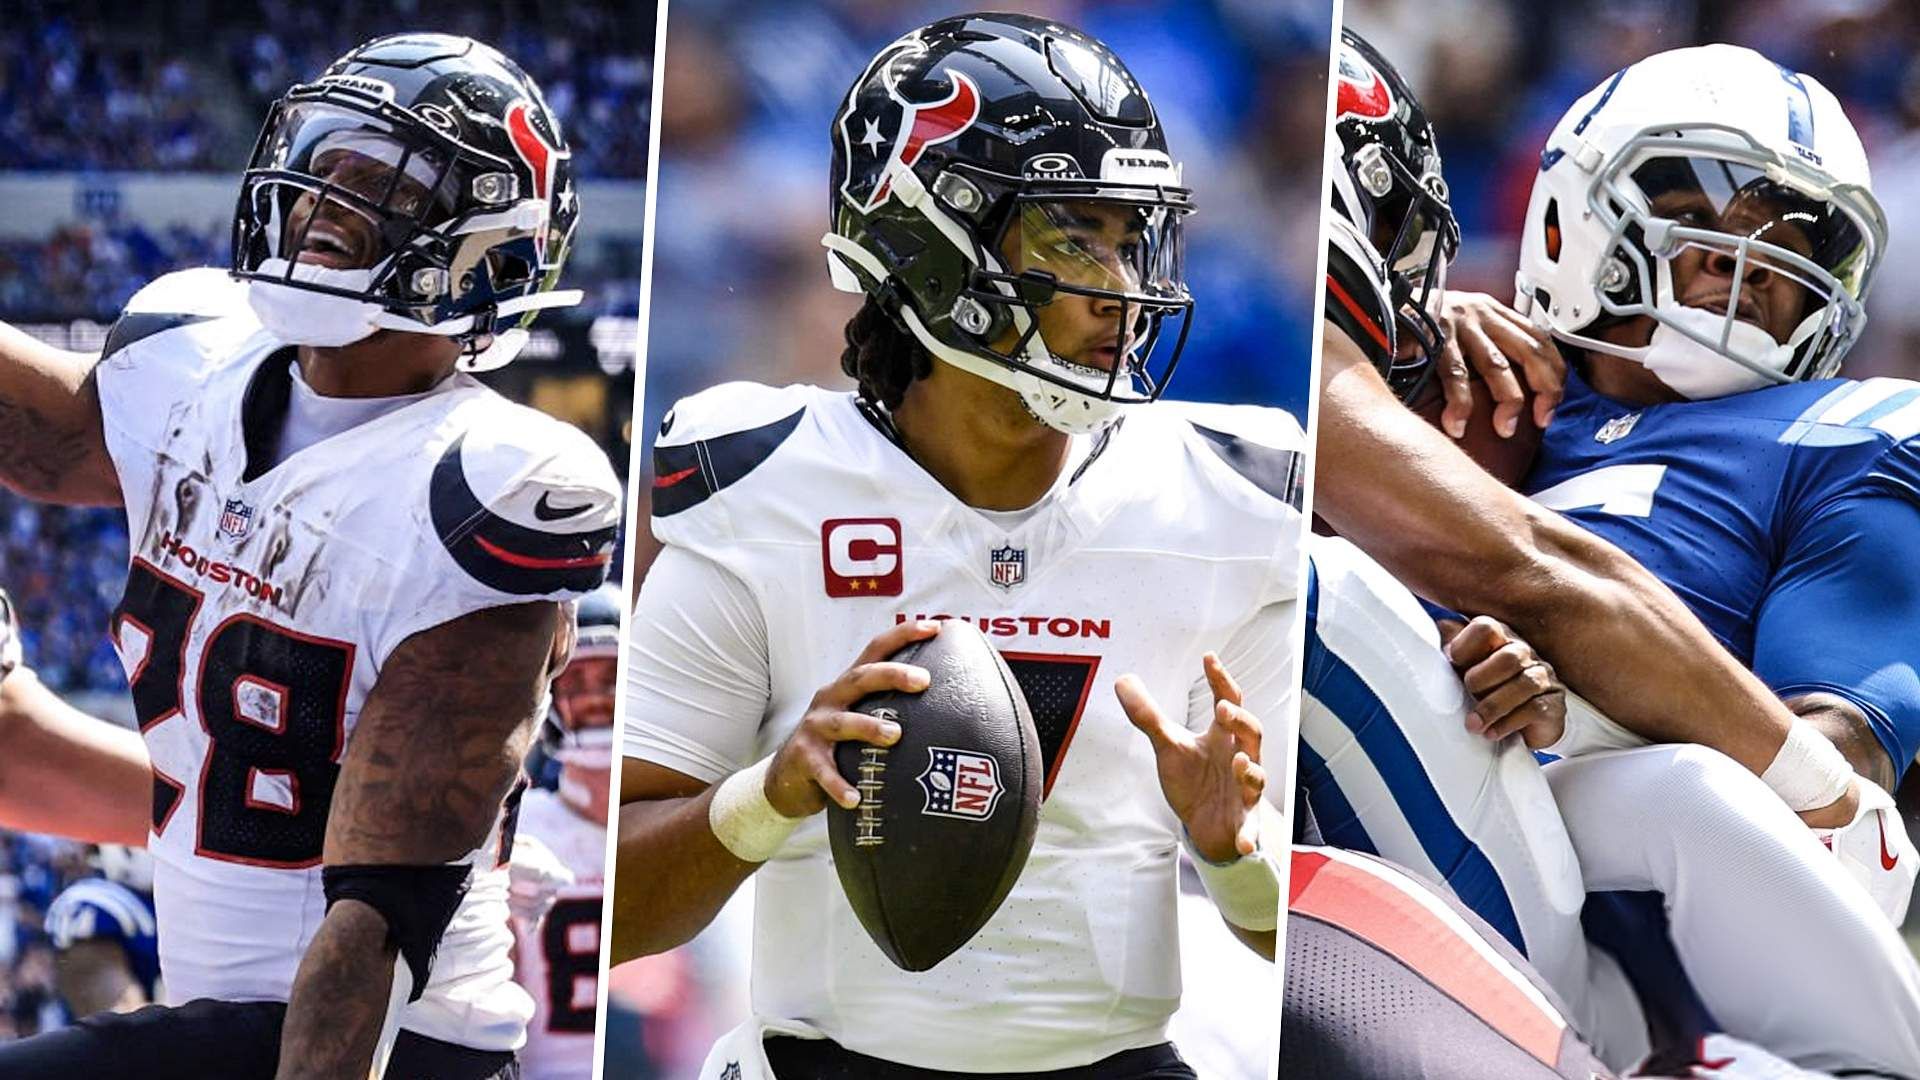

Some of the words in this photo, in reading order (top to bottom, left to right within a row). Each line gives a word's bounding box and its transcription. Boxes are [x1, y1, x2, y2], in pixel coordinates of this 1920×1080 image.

[161, 530, 283, 606] HOUSTON
[828, 523, 898, 577] C
[994, 561, 1022, 582] NFL
[895, 613, 1111, 639] STON
[954, 760, 995, 813] NFL
